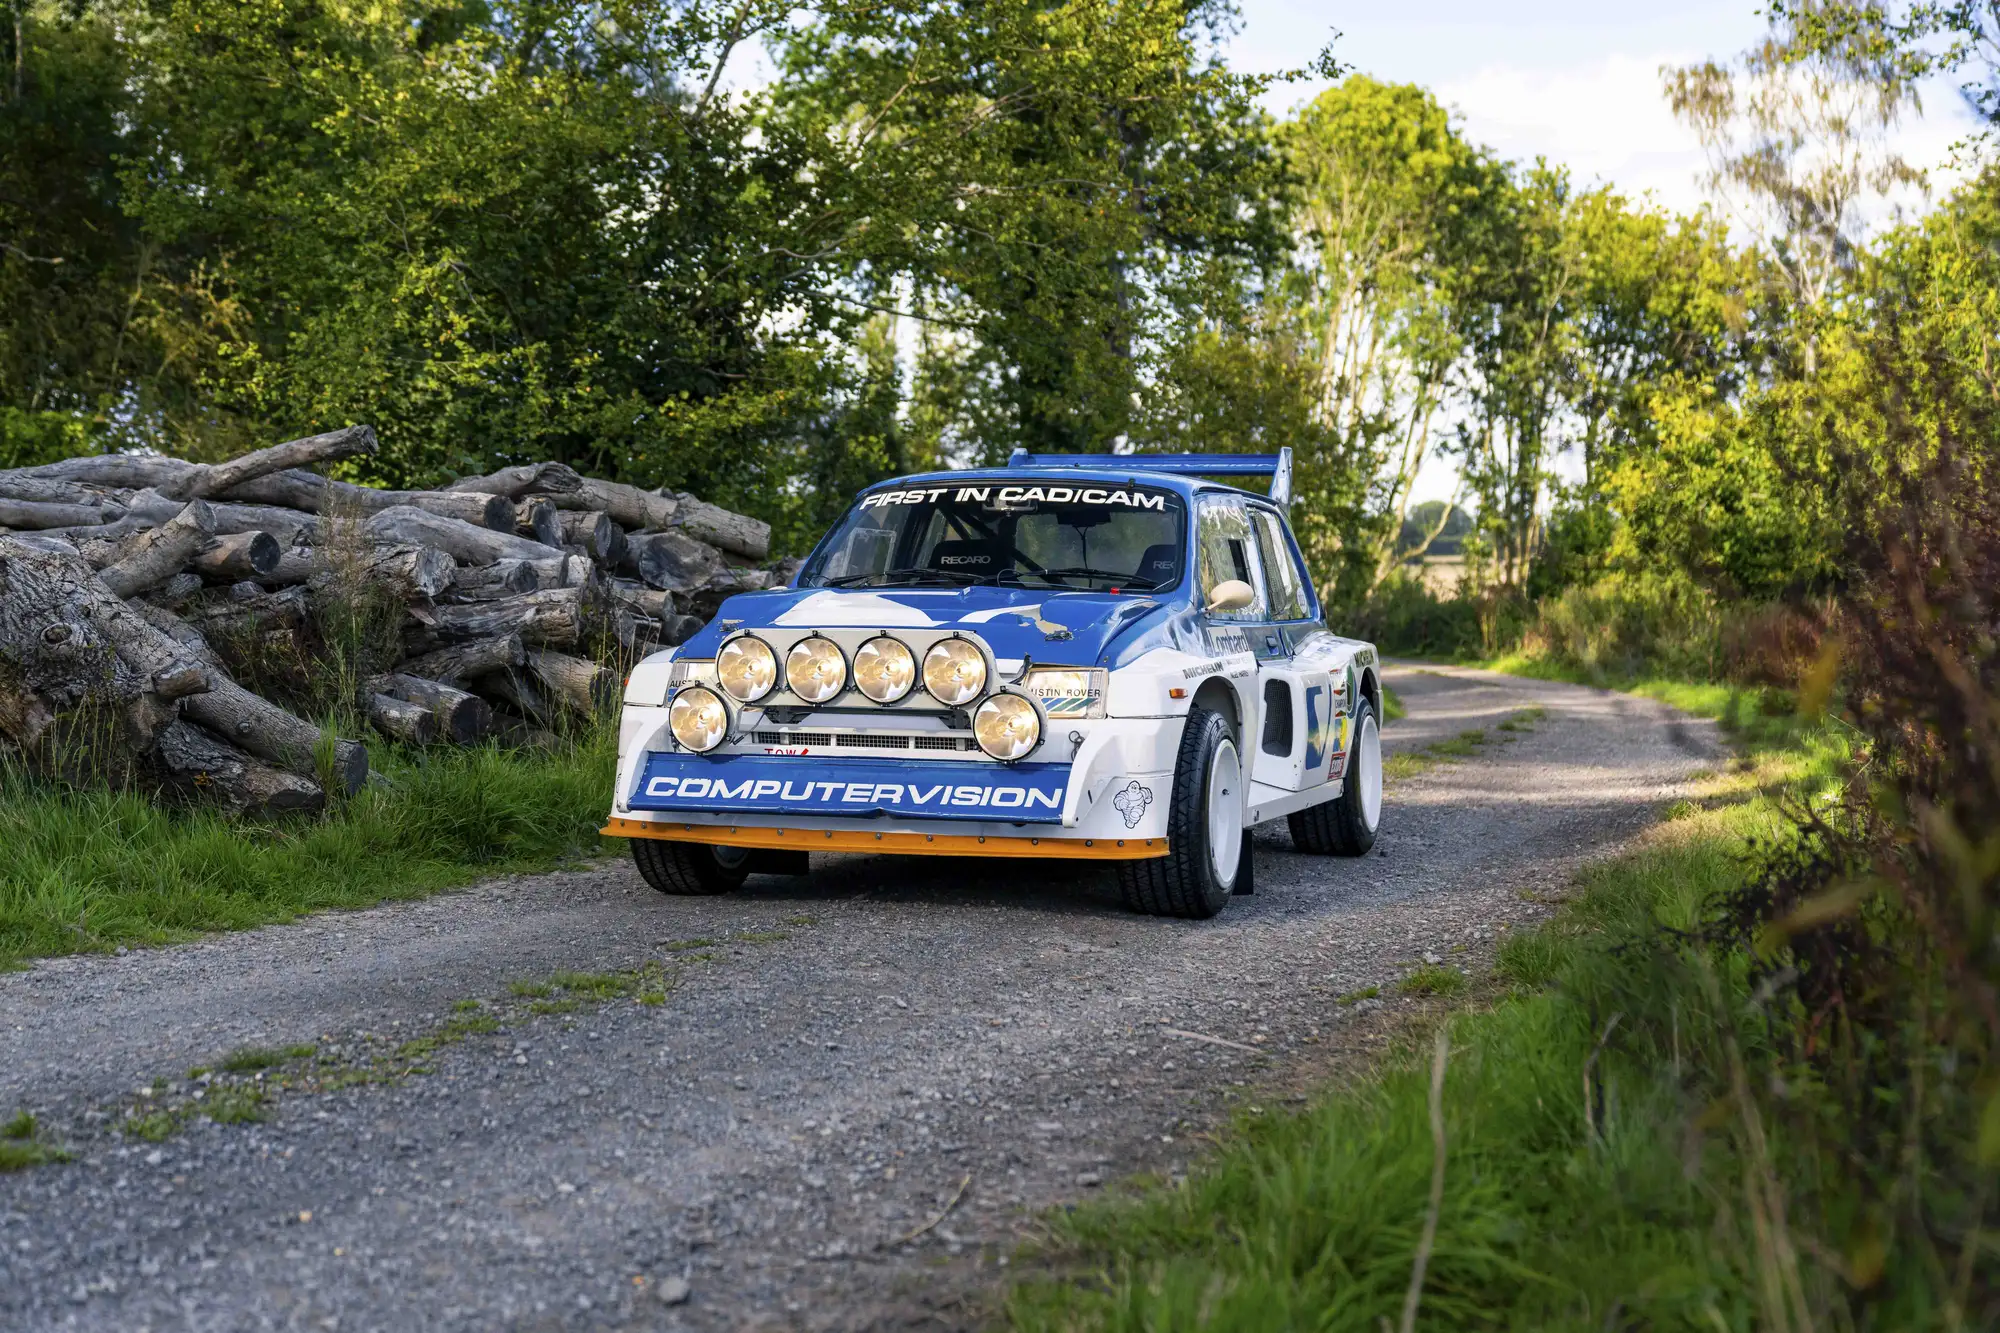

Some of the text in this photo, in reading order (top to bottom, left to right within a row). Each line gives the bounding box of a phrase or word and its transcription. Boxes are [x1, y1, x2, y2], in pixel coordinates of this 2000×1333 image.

[859, 487, 1165, 511] FIRST IN CAD/CAM
[941, 556, 991, 564] RECARO
[1182, 661, 1225, 680] MICHELIN
[1031, 688, 1100, 697] USTIN ROVER
[644, 776, 1064, 809] COMPUTERVISION
